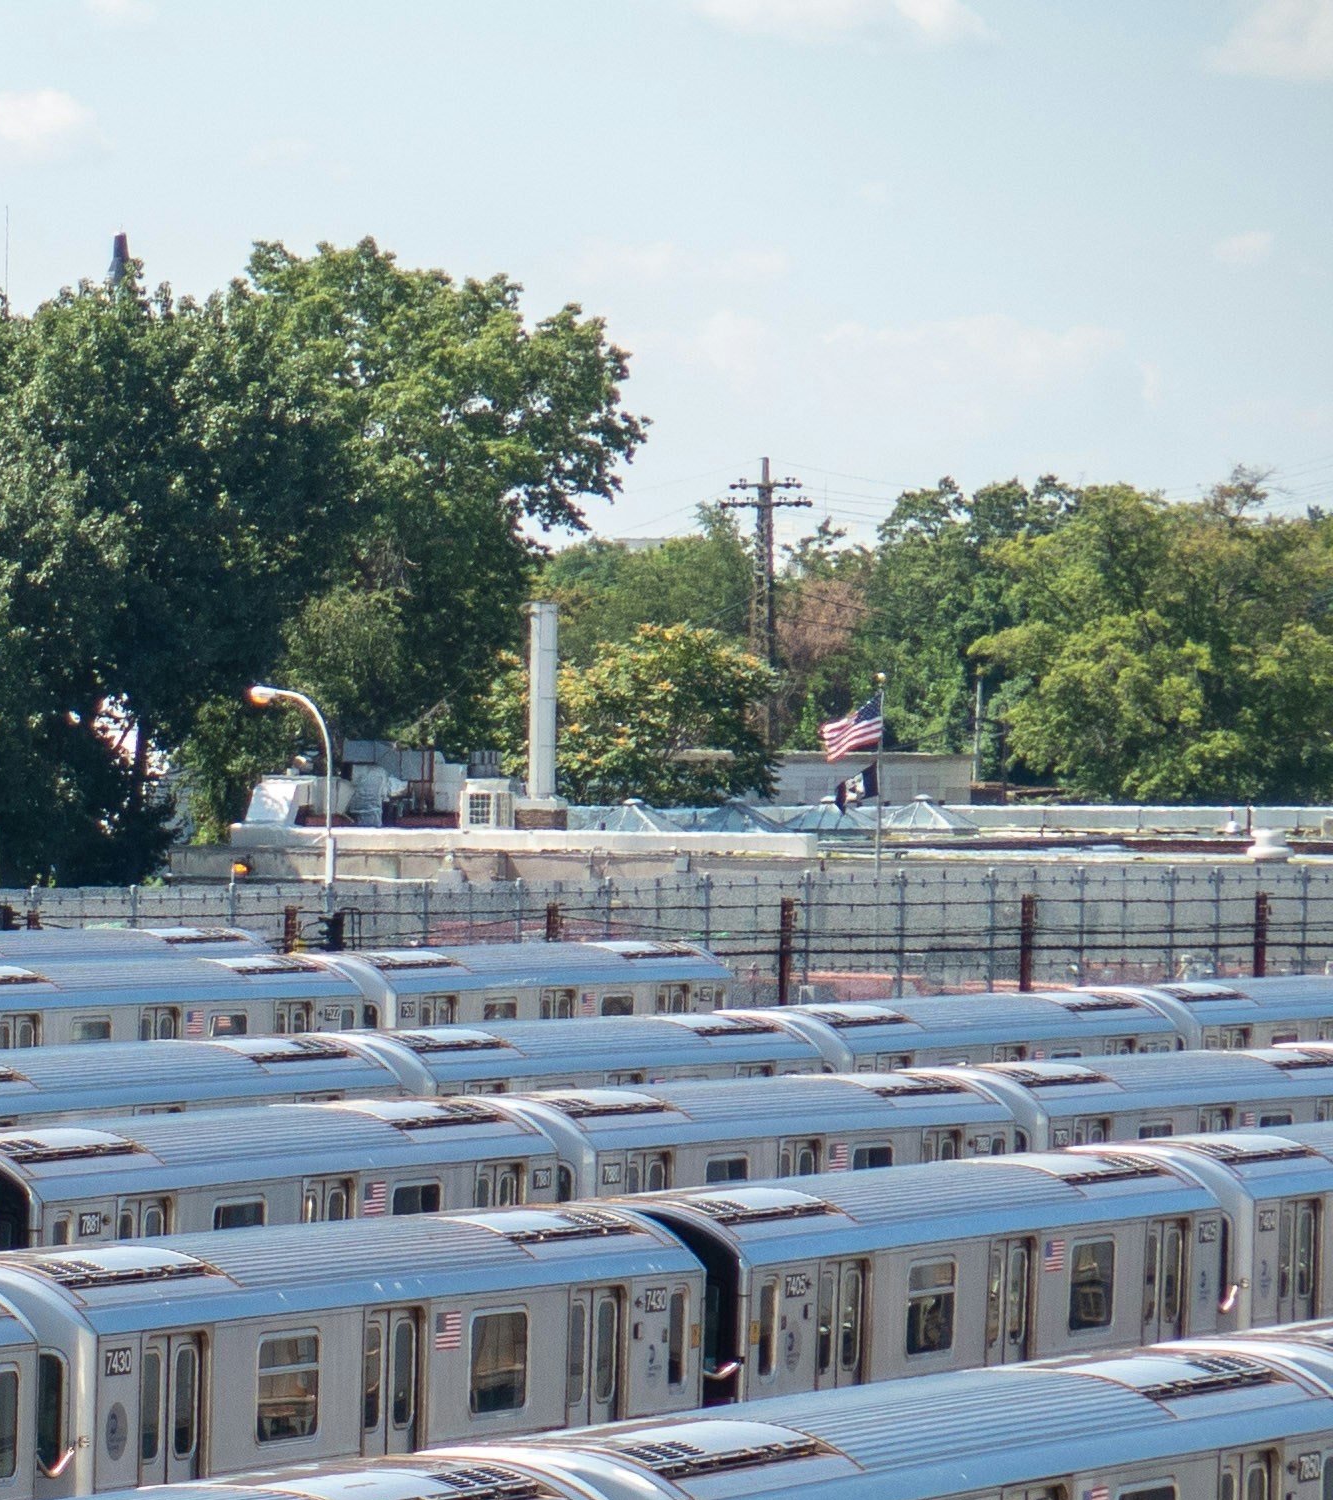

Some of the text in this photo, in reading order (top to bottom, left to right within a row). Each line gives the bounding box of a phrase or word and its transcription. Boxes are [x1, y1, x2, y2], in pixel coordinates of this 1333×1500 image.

[81, 1214, 100, 1234] 7881
[646, 1288, 666, 1311] 7430
[106, 1349, 132, 1375] 7430
